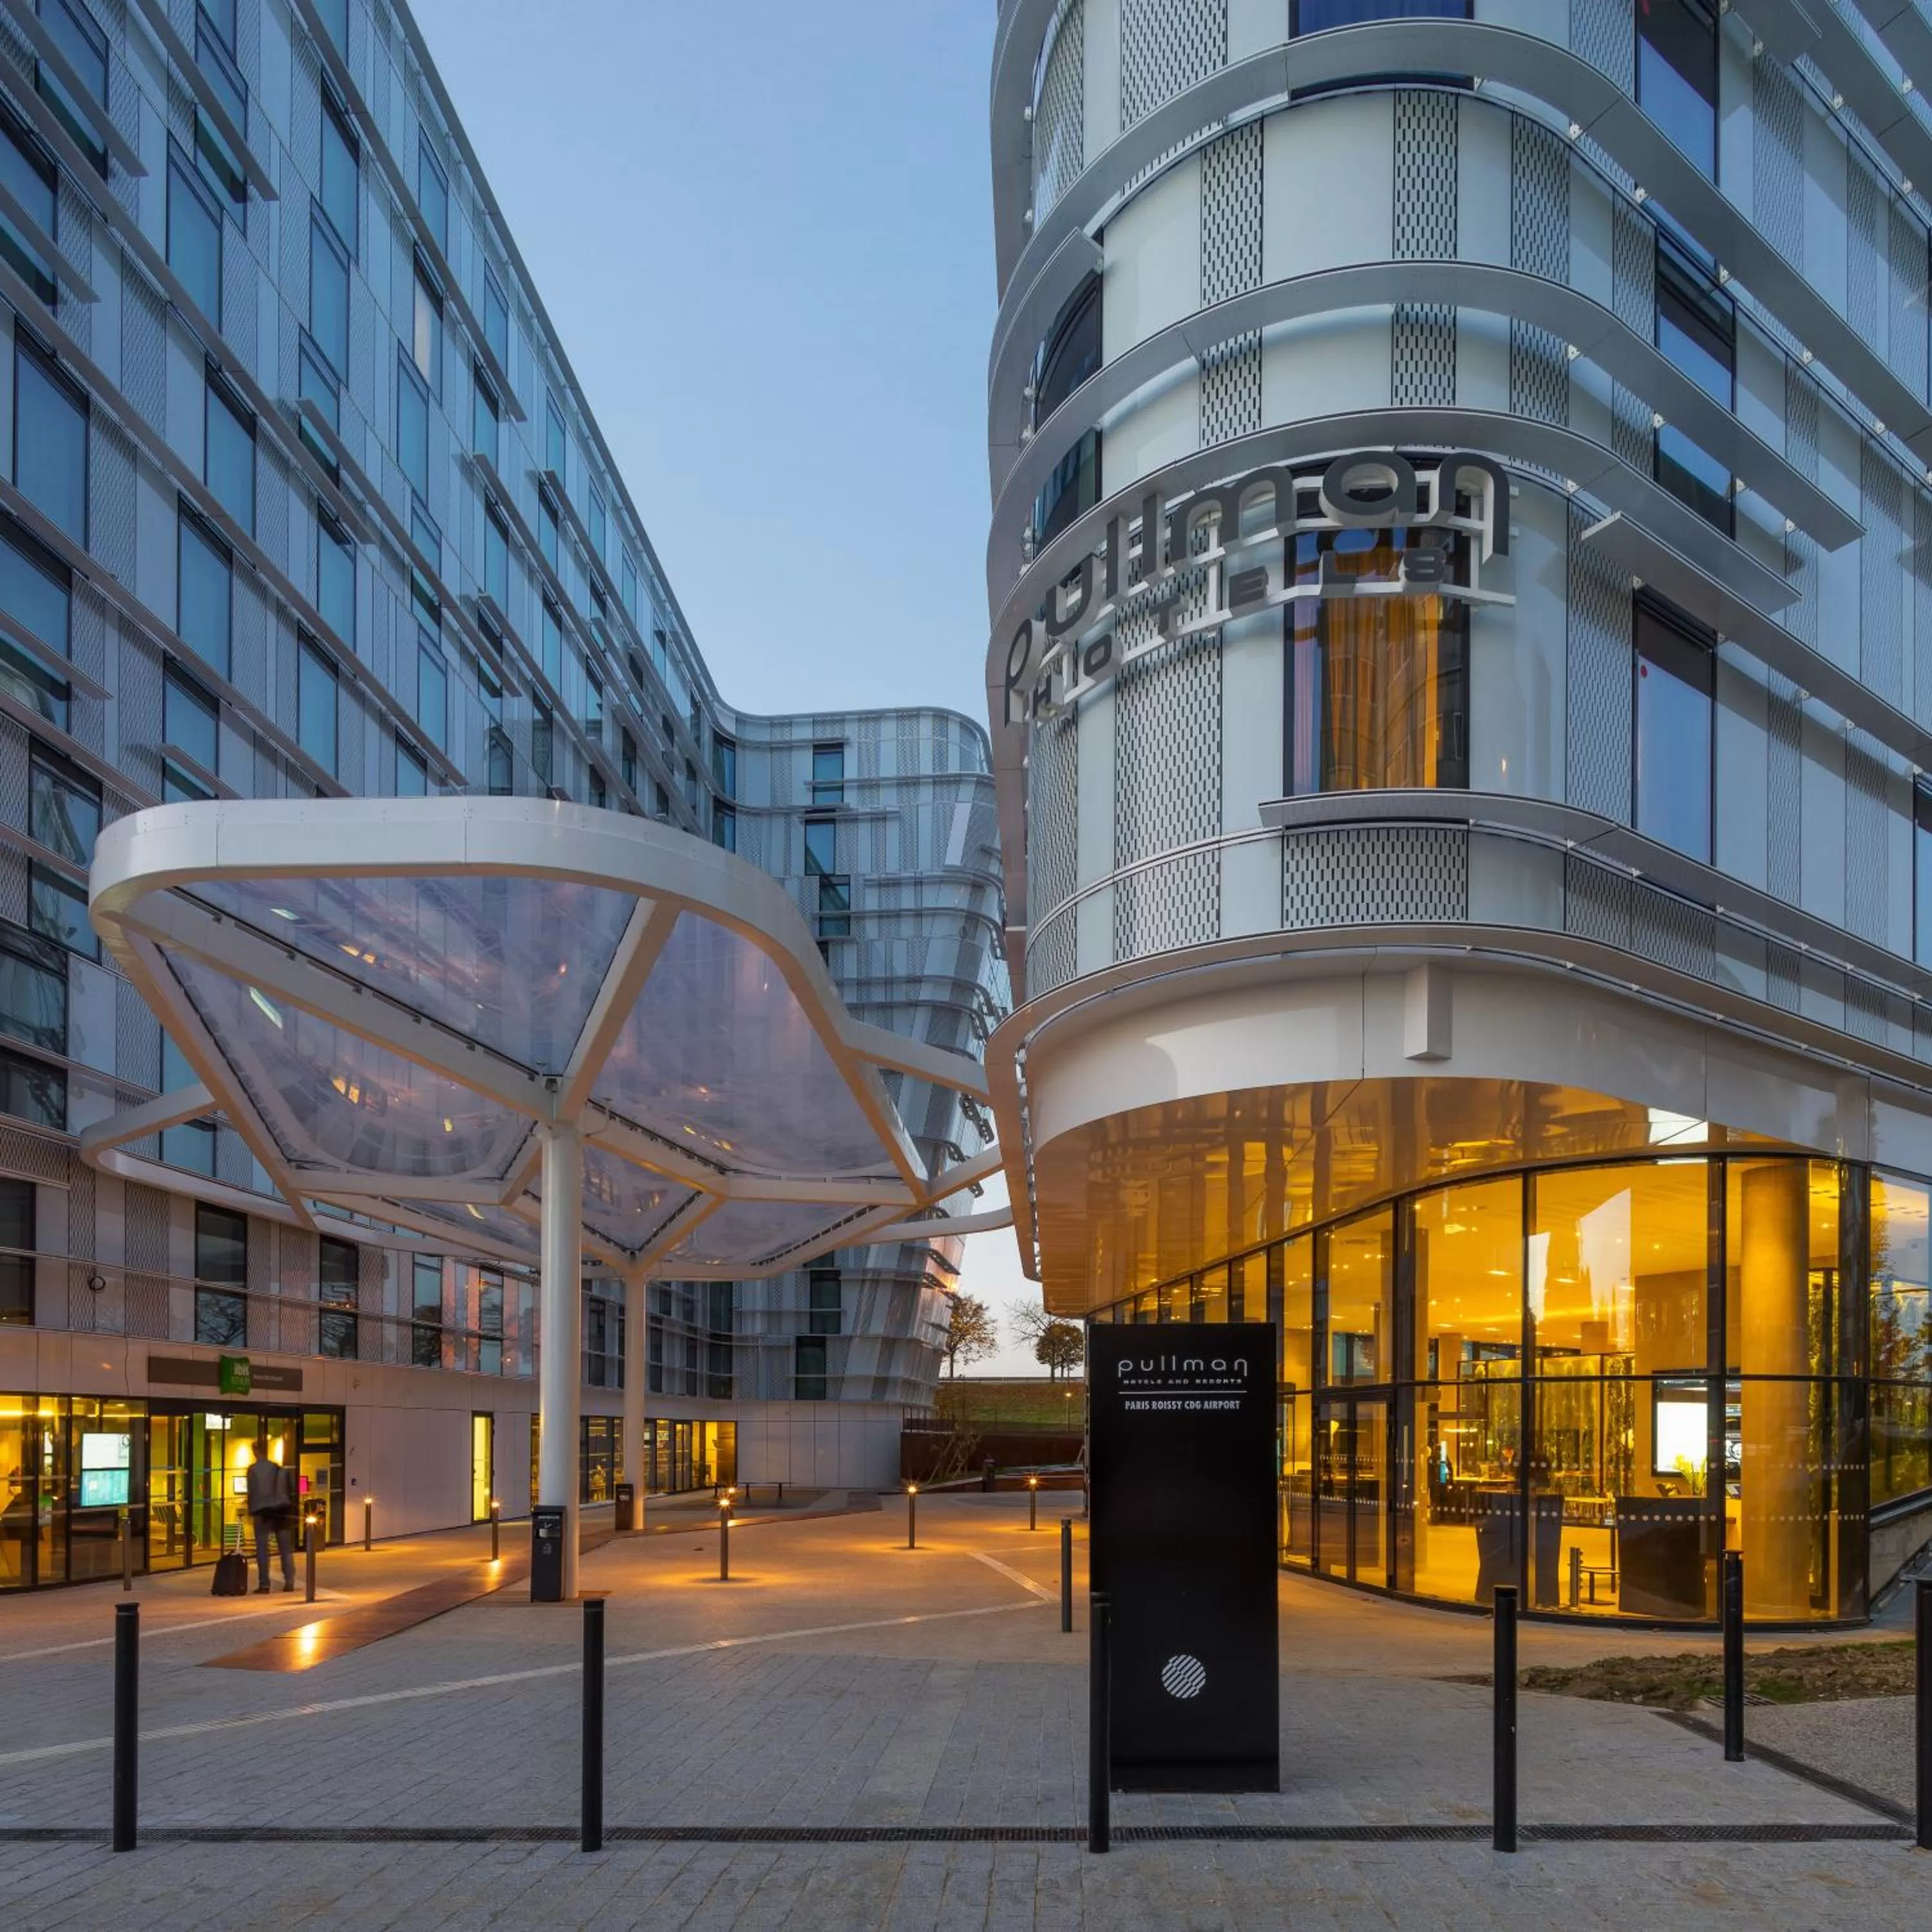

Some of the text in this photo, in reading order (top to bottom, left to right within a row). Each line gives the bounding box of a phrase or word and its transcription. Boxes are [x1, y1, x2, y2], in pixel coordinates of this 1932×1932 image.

[1004, 450, 1510, 728] pullman
[234, 1363, 249, 1376] ibis
[1118, 1355, 1247, 1378] pullman
[1125, 1401, 1241, 1410] PARIS ROISSY CDG AIRPORT
